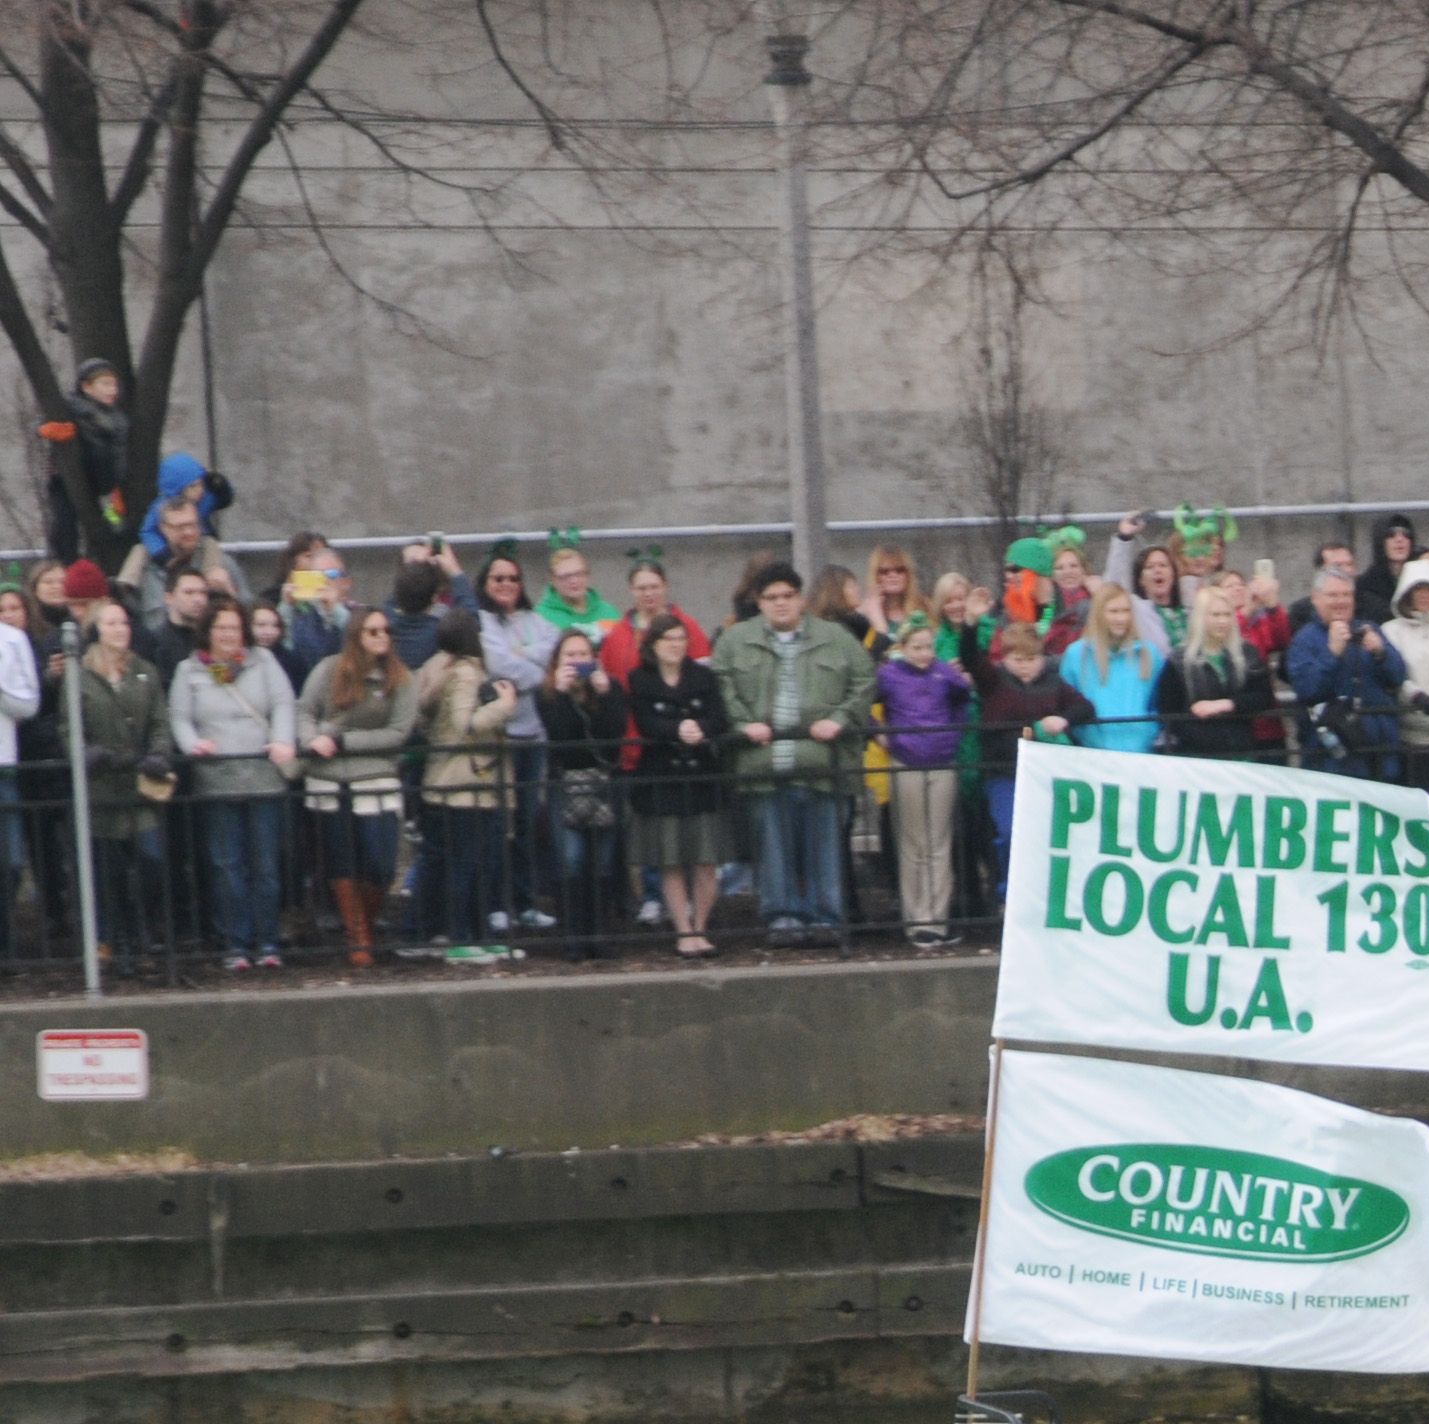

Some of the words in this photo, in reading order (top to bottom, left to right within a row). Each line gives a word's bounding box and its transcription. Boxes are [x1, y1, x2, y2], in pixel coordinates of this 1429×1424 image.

[1044, 854, 1291, 950] LOCAL
[1166, 951, 1314, 1034] U.A.
[1077, 1154, 1362, 1230] COUNTRY
[1130, 1208, 1307, 1250] FINANCIAL
[1014, 1262, 1062, 1280] AUTO
[1082, 1269, 1131, 1287] HOME
[1152, 1276, 1187, 1293] LIFE
[1202, 1283, 1285, 1306] BUSINESS
[1304, 1293, 1410, 1309] RETIREMENT
